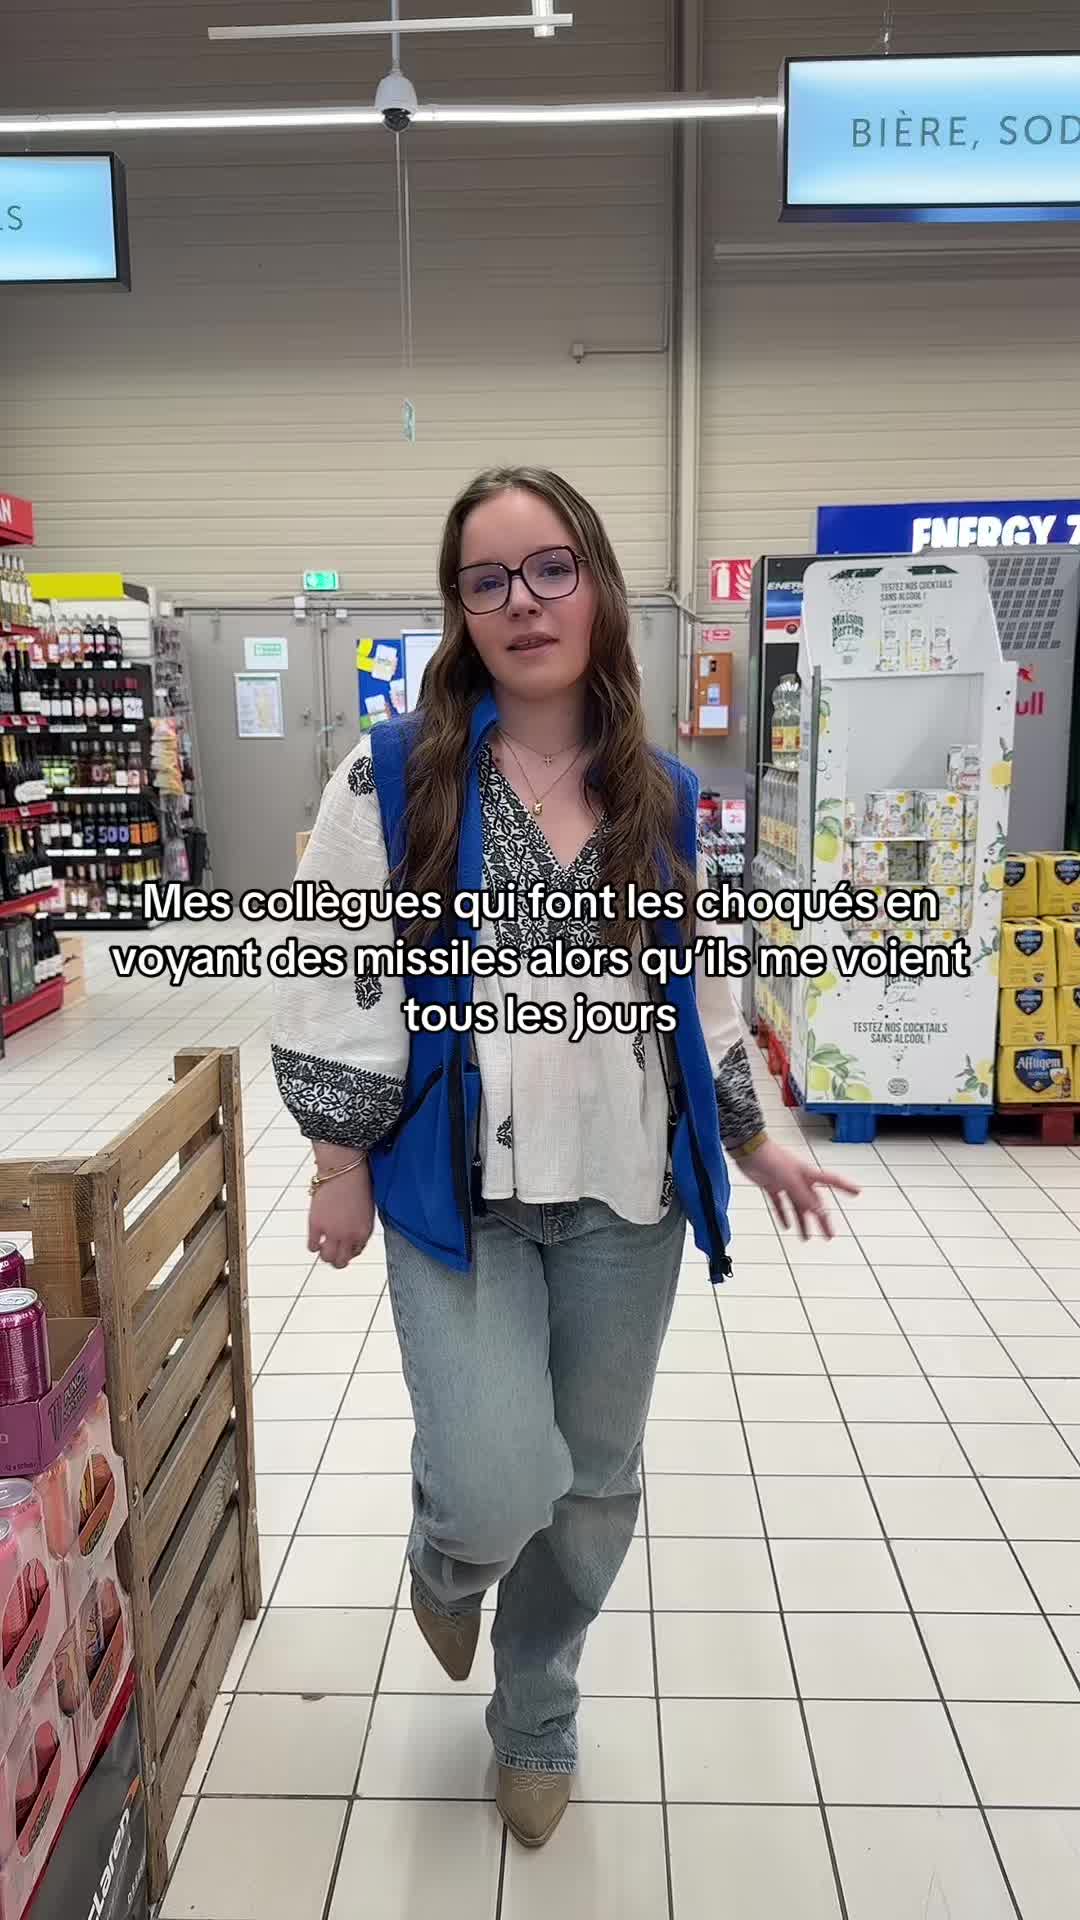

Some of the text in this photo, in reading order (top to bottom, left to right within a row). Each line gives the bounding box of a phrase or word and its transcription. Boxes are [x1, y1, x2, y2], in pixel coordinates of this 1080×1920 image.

[851, 109, 979, 150] BIÈRE,
[853, 1022, 948, 1034] TESTEZ NOS COCKTAILS
[870, 1033, 893, 1044] SANS
[894, 1033, 926, 1045] ALCOOL
